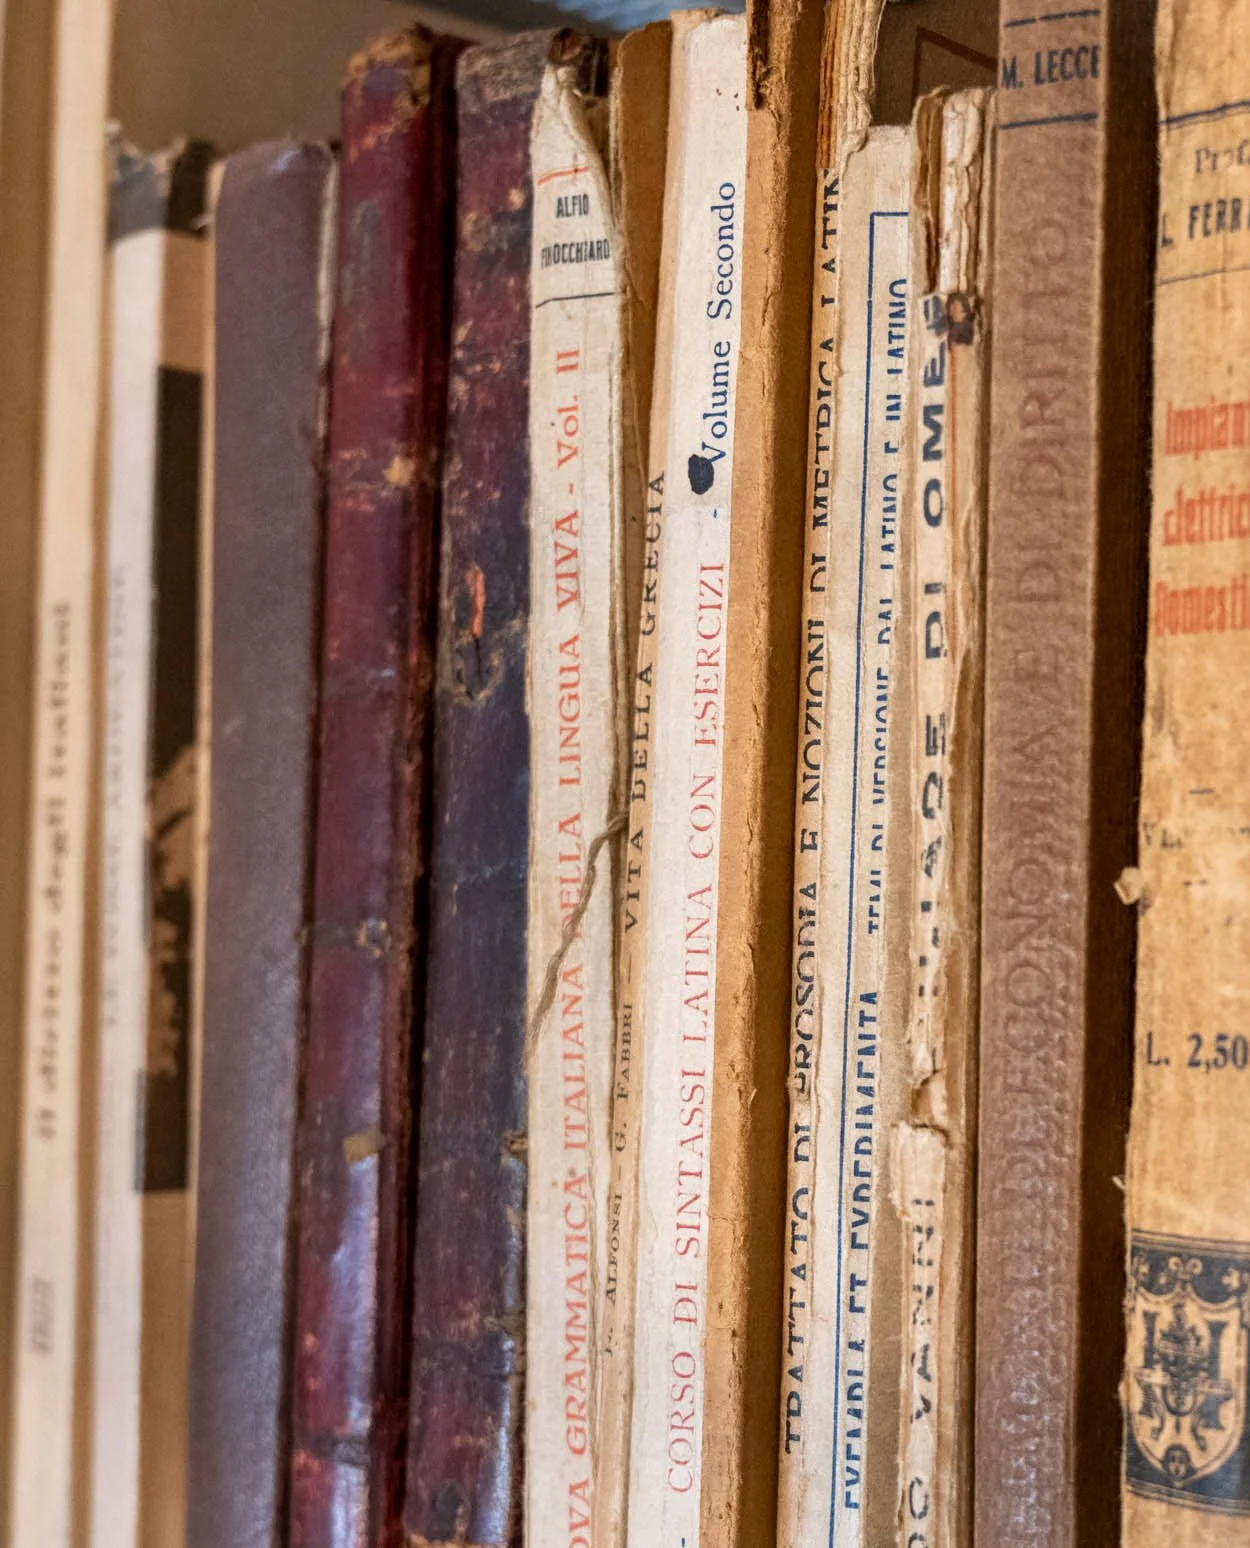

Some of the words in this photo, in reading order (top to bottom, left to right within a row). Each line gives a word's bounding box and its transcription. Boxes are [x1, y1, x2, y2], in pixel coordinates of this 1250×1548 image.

[1001, 55, 1024, 89] M.
[555, 193, 590, 219] ALFIO
[705, 181, 736, 320] Secondo
[555, 348, 580, 375] II
[700, 340, 732, 465] Volume
[556, 395, 580, 470] Vol.
[553, 509, 580, 612] VIVA
[640, 470, 665, 637] GRECIA
[692, 561, 725, 747] ESERCIZI
[922, 581, 946, 660] DI
[557, 632, 582, 787] LINGUA
[630, 662, 653, 802] DELLA
[687, 774, 717, 860] CON
[624, 827, 645, 934] VITA
[682, 883, 714, 1043] LATINA
[561, 962, 587, 1151] ITALIANA
[615, 1002, 633, 1101] FABBRI
[1145, 1031, 1170, 1066] L.
[1186, 1032, 1249, 1074] 2,50
[613, 1123, 628, 1153] G.
[673, 1067, 706, 1259] SINTASSI
[604, 1192, 623, 1305] ALFONSI
[562, 1173, 589, 1456] GRAMMATICA
[671, 1282, 699, 1326] DI
[666, 1351, 698, 1494] CORSO
